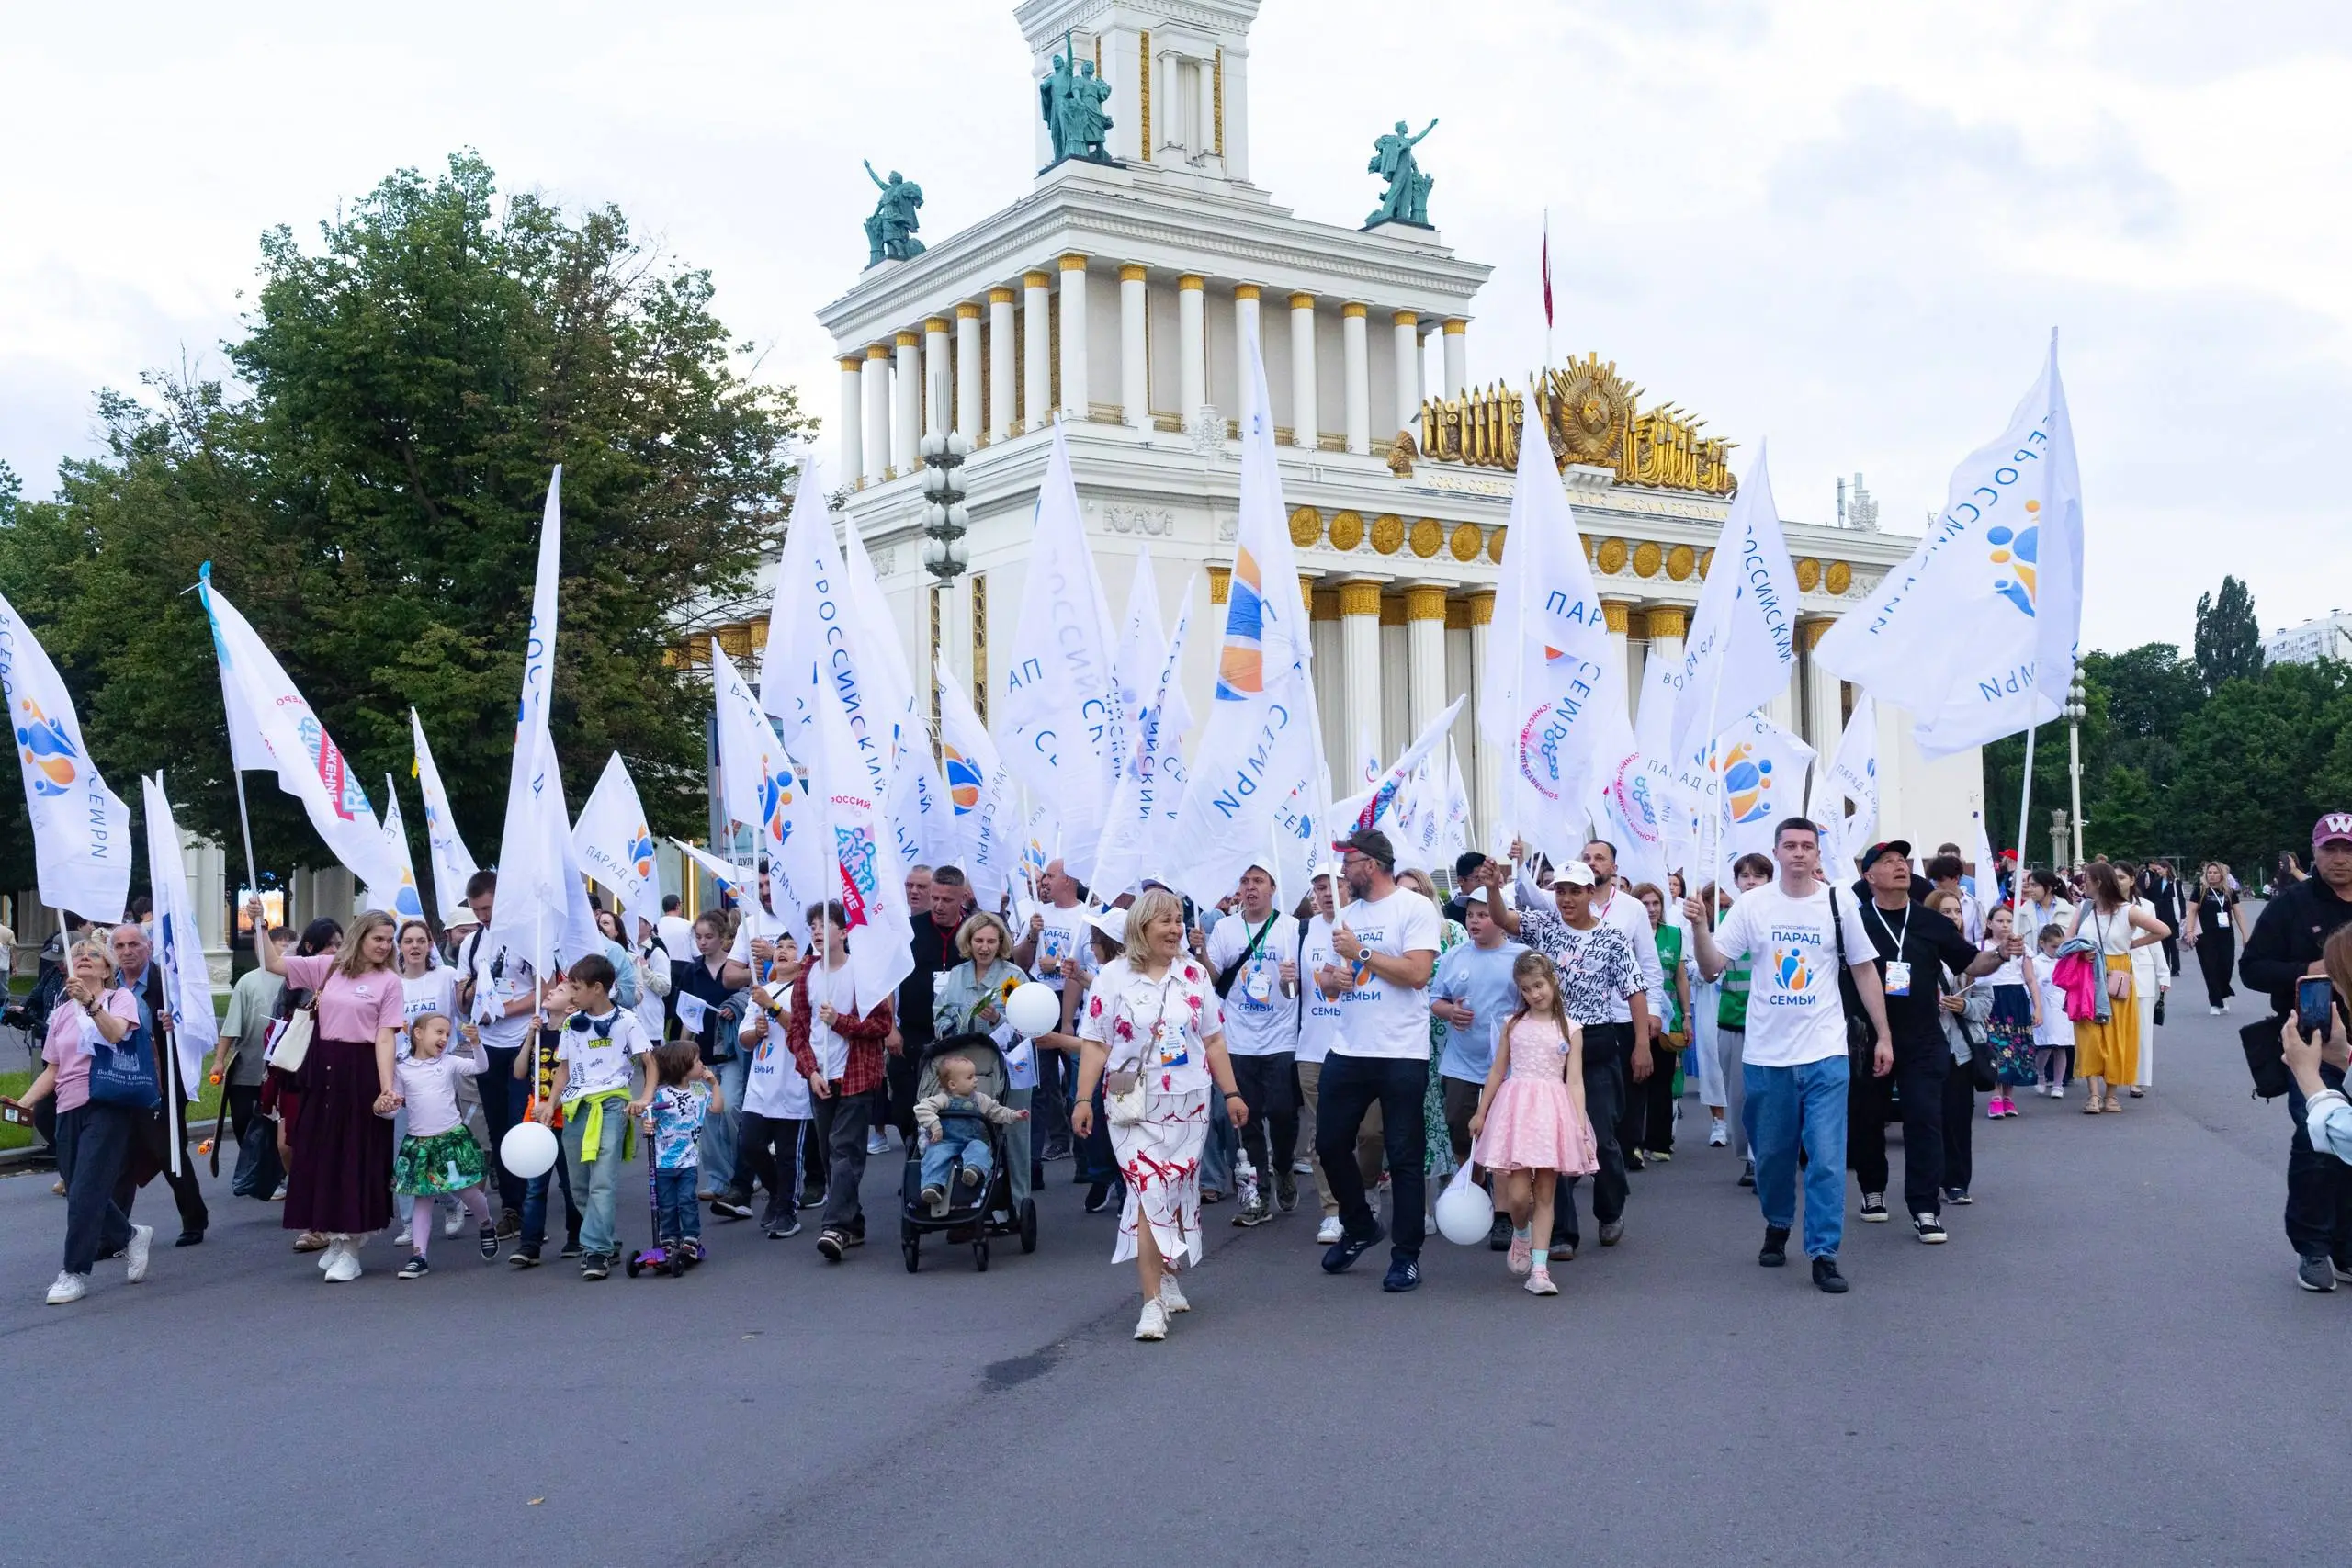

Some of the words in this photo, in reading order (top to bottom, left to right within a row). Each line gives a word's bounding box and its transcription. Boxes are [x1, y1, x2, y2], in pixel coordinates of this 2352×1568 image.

[1546, 590, 1609, 636] ПАР
[2324, 815, 2352, 833] W
[1356, 931, 1384, 942] АРАД
[1771, 931, 1821, 945] ПАРАД
[1341, 991, 1382, 1003] СЕМЬИ
[1770, 995, 1816, 1006] СЕМЬИ
[1238, 1002, 1275, 1013] СЕМЬИ
